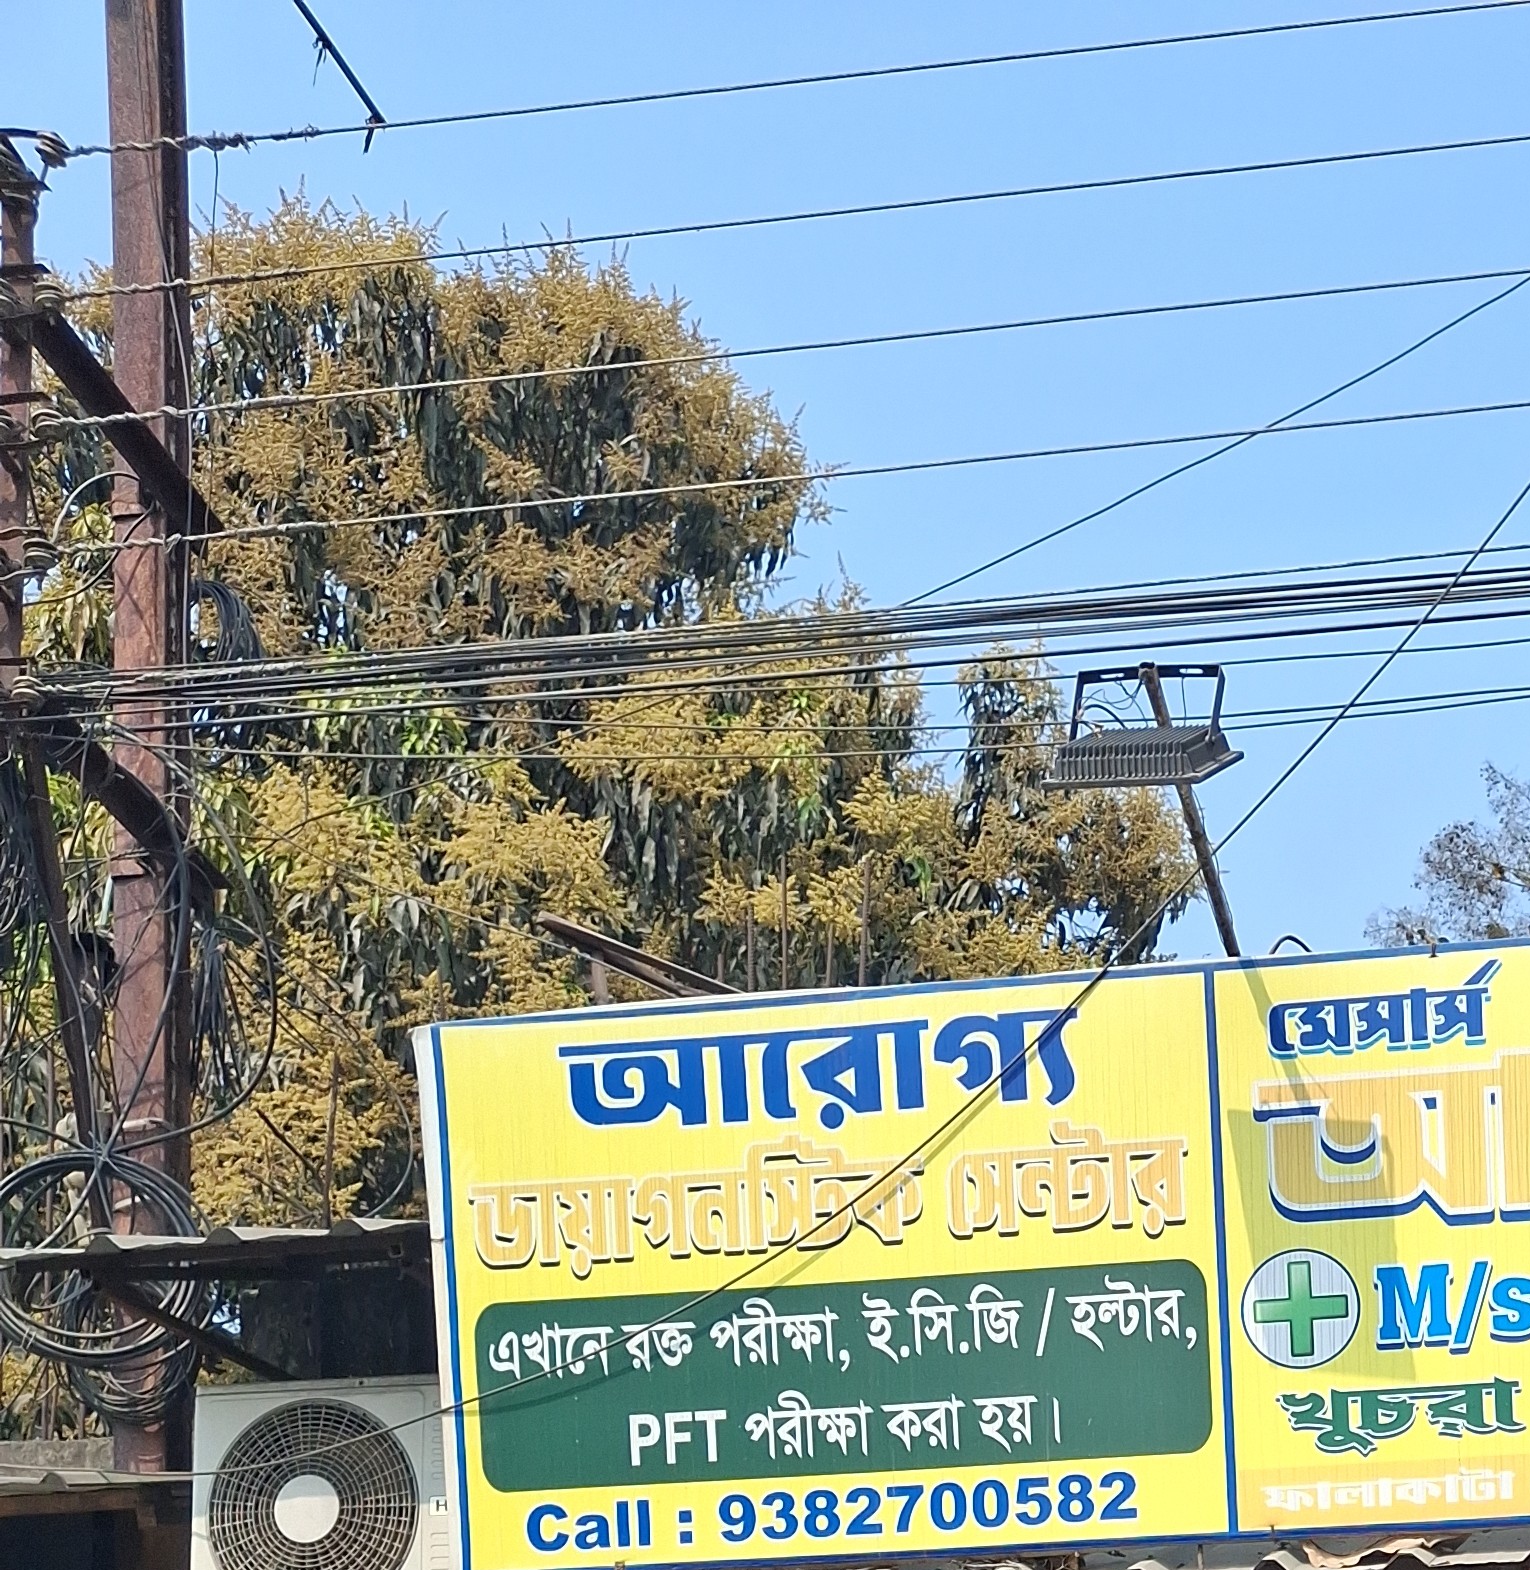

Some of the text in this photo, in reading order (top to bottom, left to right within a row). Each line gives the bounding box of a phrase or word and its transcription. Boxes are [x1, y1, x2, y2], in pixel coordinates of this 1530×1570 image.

[1267, 958, 1502, 1059] মেসার্স
[559, 1006, 1079, 1130] আরোগ্য
[468, 1122, 1189, 1281] ডায়াগনস্টিক সেন্টার
[487, 1322, 611, 1381] এখানে
[623, 1321, 695, 1374] রক্ত
[708, 1298, 853, 1374] পরীক্ষা,
[628, 1410, 728, 1467] PFT
[744, 1391, 872, 1460] পরীক্ষা
[886, 1394, 962, 1452] করা
[1277, 1376, 1527, 1458] খুচরা
[526, 1498, 651, 1552] Call
[718, 1471, 1138, 1542] 9382700582
[1261, 1469, 1516, 1512] ফালাকাটা
